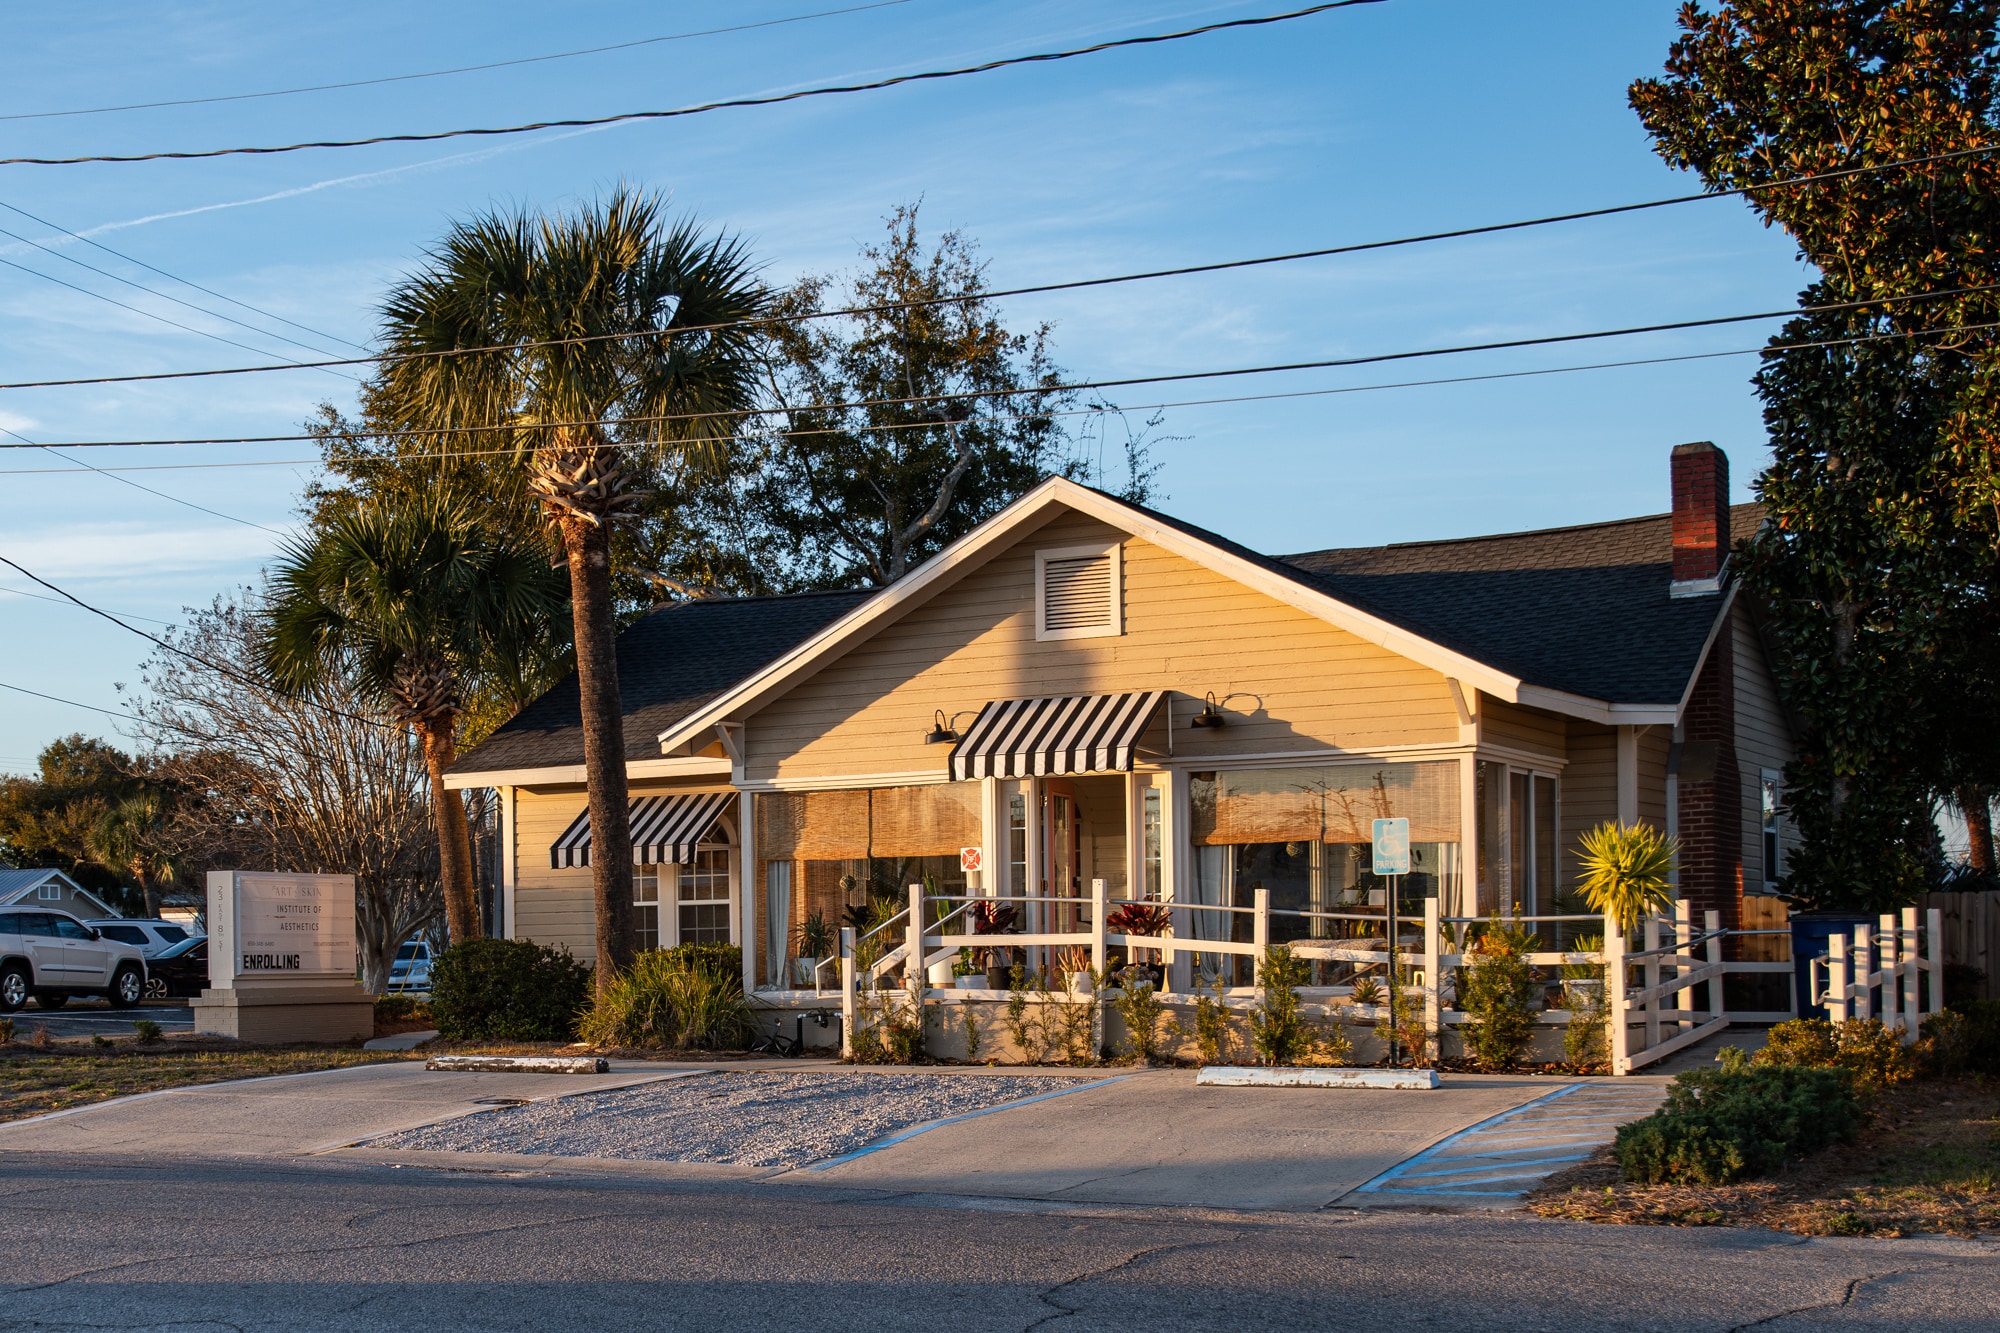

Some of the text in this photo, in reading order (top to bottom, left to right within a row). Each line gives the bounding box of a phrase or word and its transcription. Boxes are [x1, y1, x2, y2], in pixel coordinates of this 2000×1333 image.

[1375, 859, 1407, 869] PARKING
[217, 885, 223, 901] 23
[275, 887, 292, 897] ART
[301, 887, 322, 897] SKIN
[276, 904, 322, 914] INSTITUTE OF
[280, 922, 319, 931] AESTHETICS
[243, 954, 300, 969] ENROLLING
